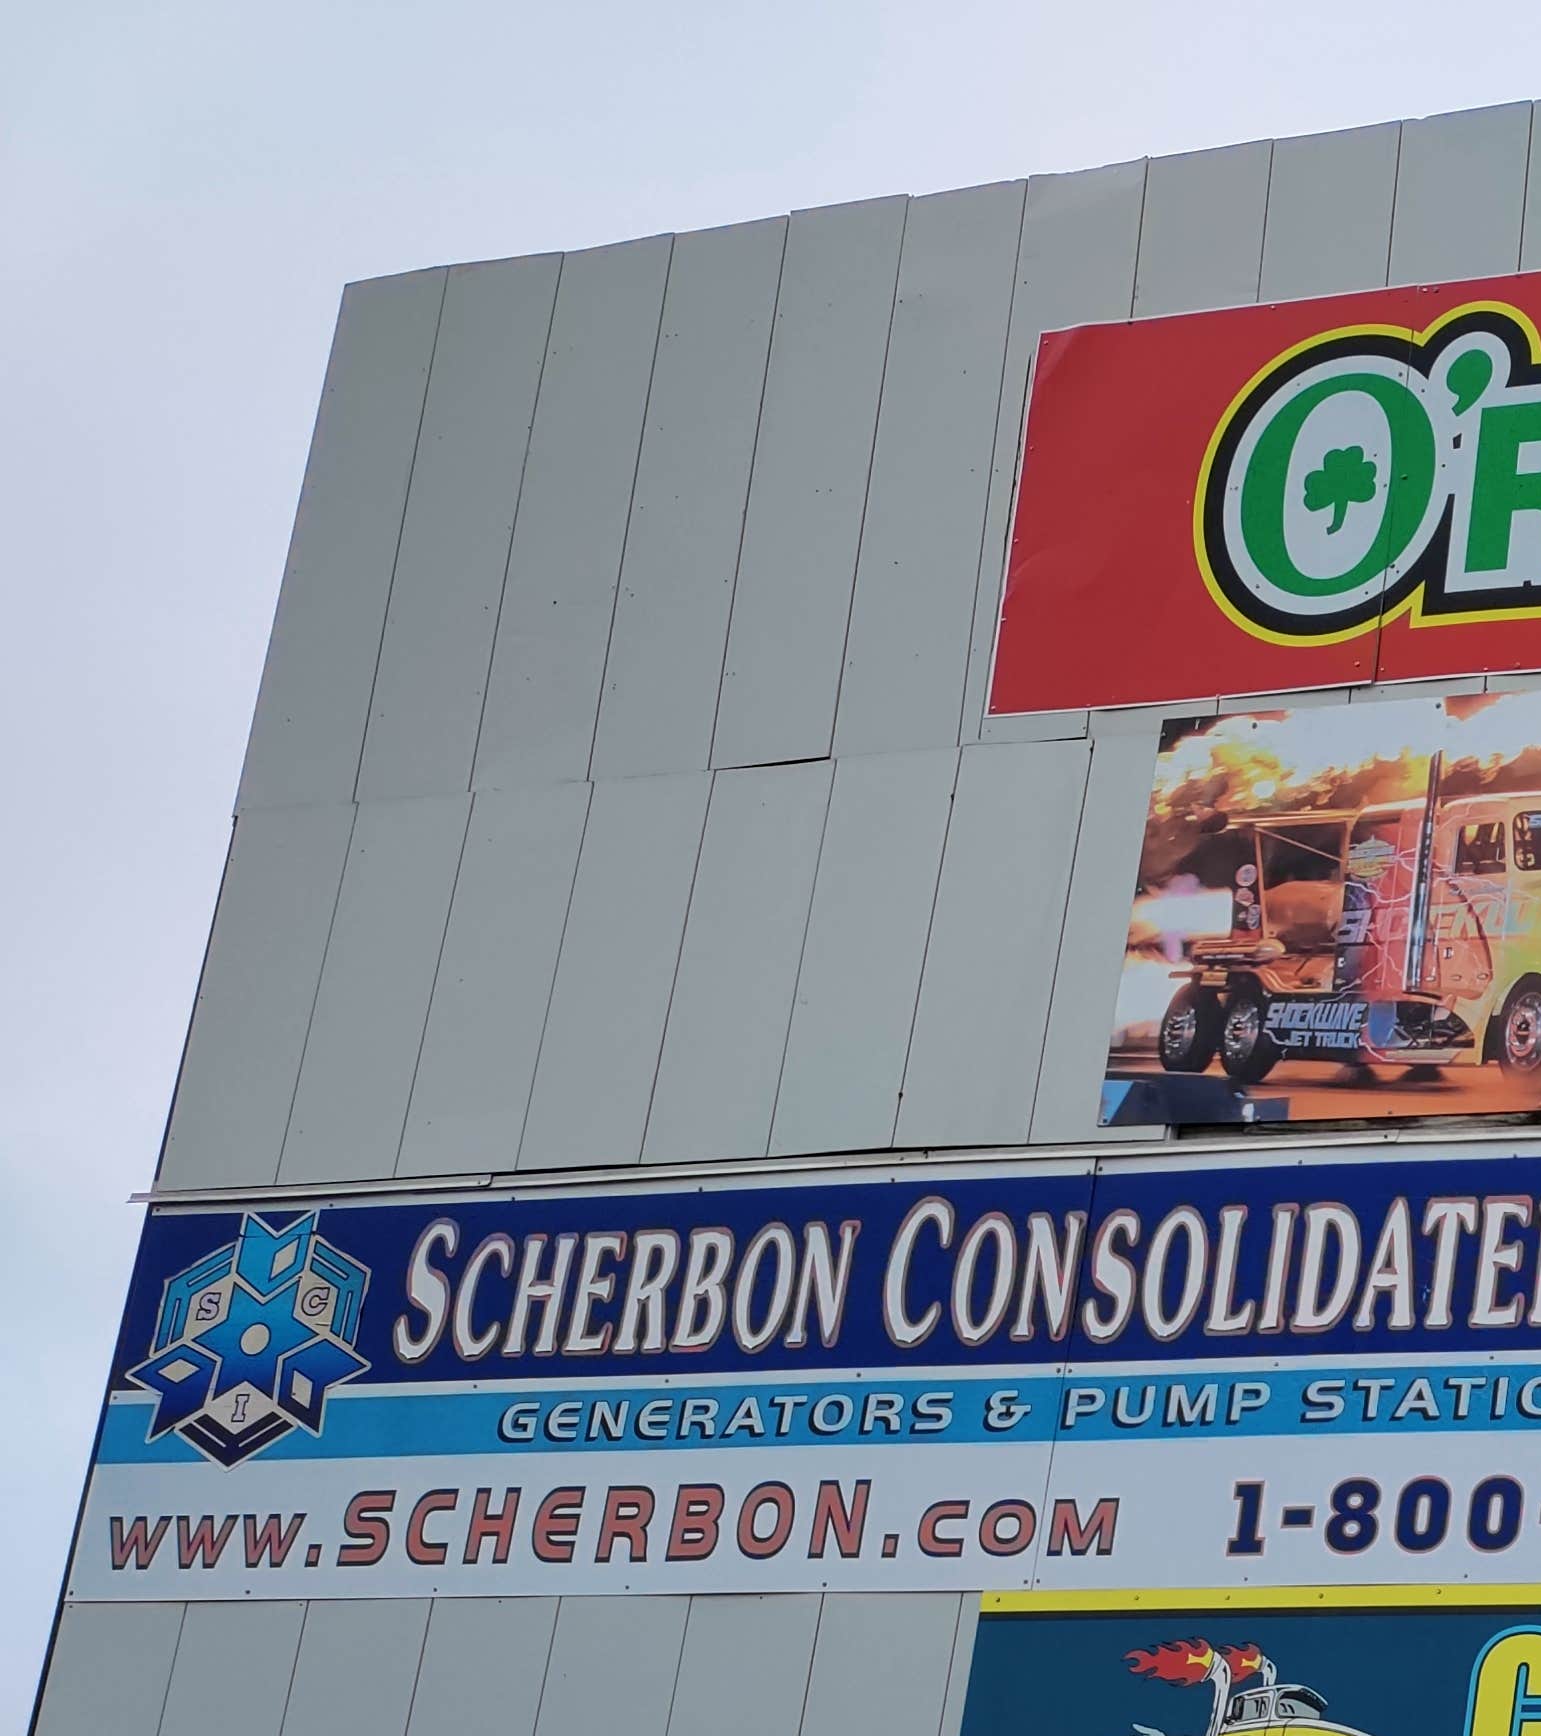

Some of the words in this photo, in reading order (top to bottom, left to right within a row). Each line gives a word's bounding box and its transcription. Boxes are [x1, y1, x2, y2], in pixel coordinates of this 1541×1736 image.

[1264, 1002, 1368, 1030] SHOCKWAVE
[1284, 1030, 1313, 1047] JET
[1314, 1031, 1360, 1049] TRUCK
[391, 1213, 862, 1364] SCHERBON
[495, 1389, 956, 1445] GENERATORS
[981, 1389, 1032, 1430] &
[1058, 1382, 1271, 1428] PUMP
